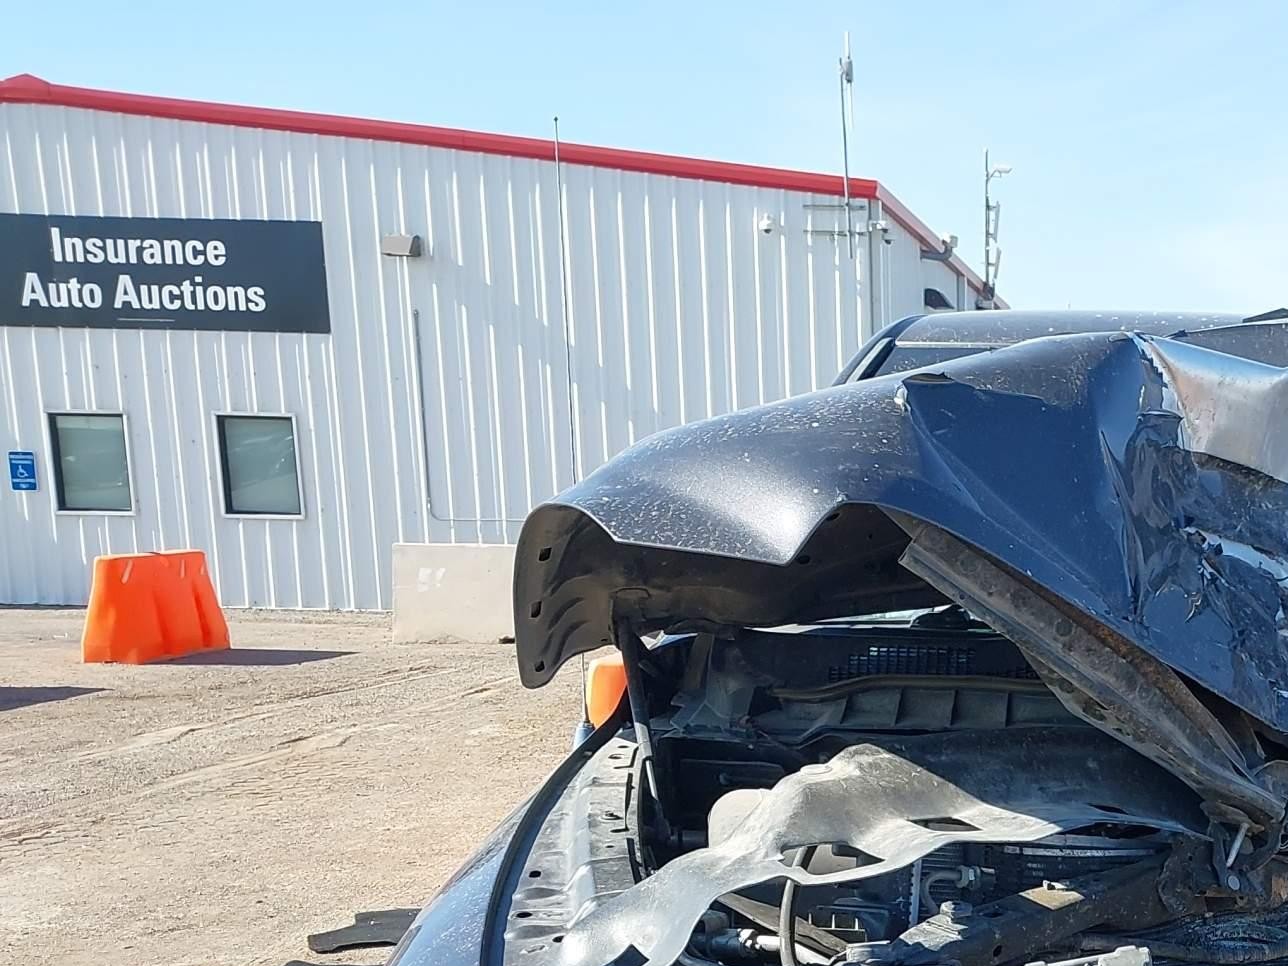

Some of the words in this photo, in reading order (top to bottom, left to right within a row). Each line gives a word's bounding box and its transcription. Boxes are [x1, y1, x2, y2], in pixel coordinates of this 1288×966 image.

[50, 227, 226, 266] Insurance
[21, 272, 103, 309] Auto
[113, 274, 267, 312] Auctions
